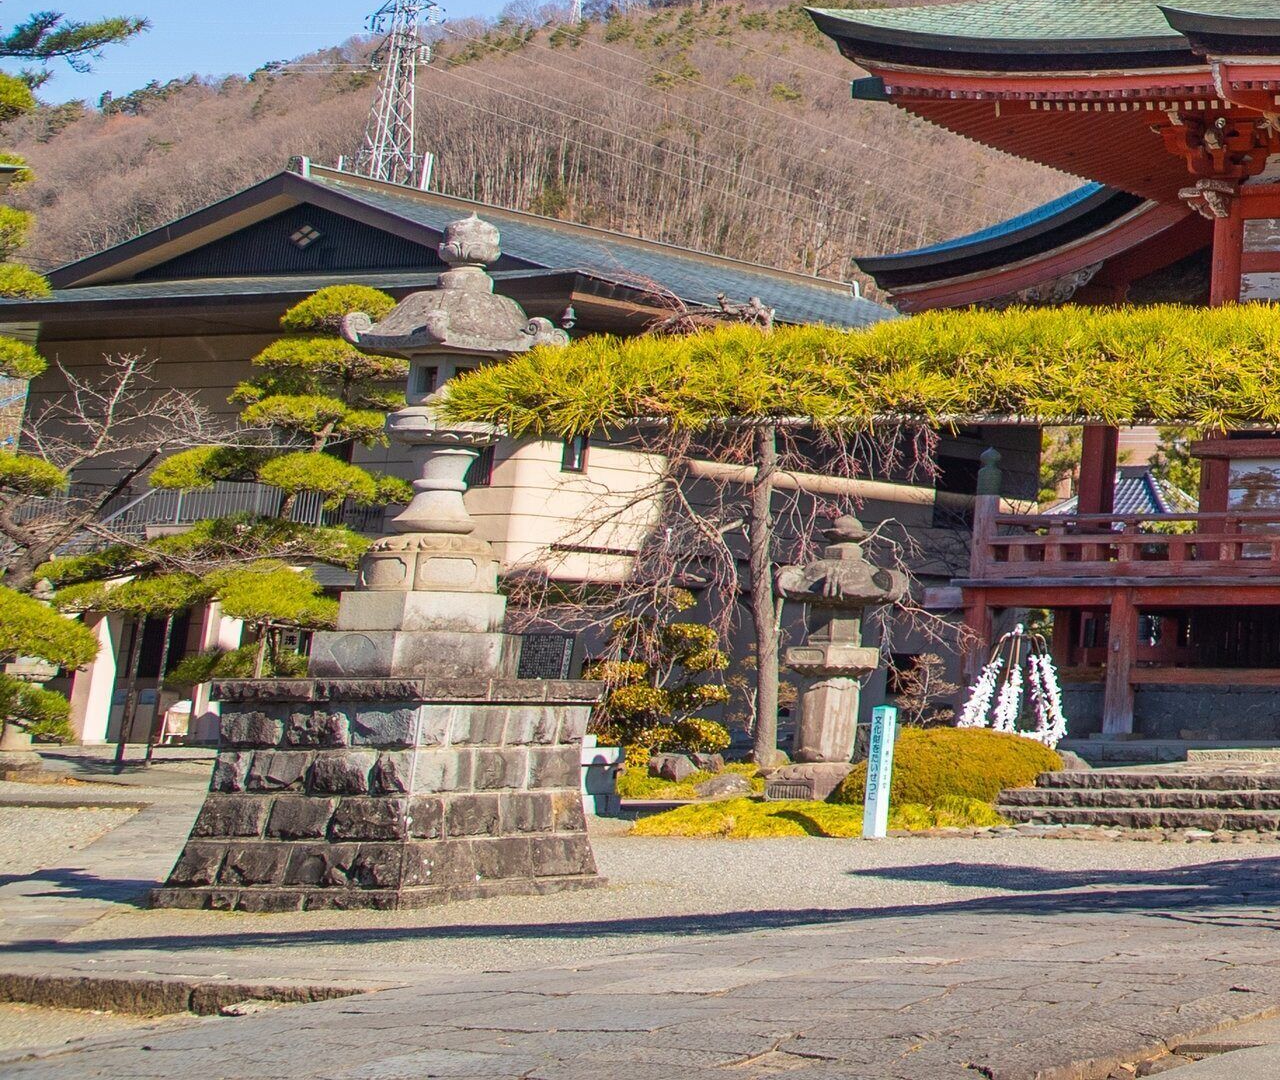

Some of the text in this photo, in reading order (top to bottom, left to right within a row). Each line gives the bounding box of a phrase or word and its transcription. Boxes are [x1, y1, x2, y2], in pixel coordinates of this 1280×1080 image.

[868, 716, 881, 800] 文化財をたいせつに
